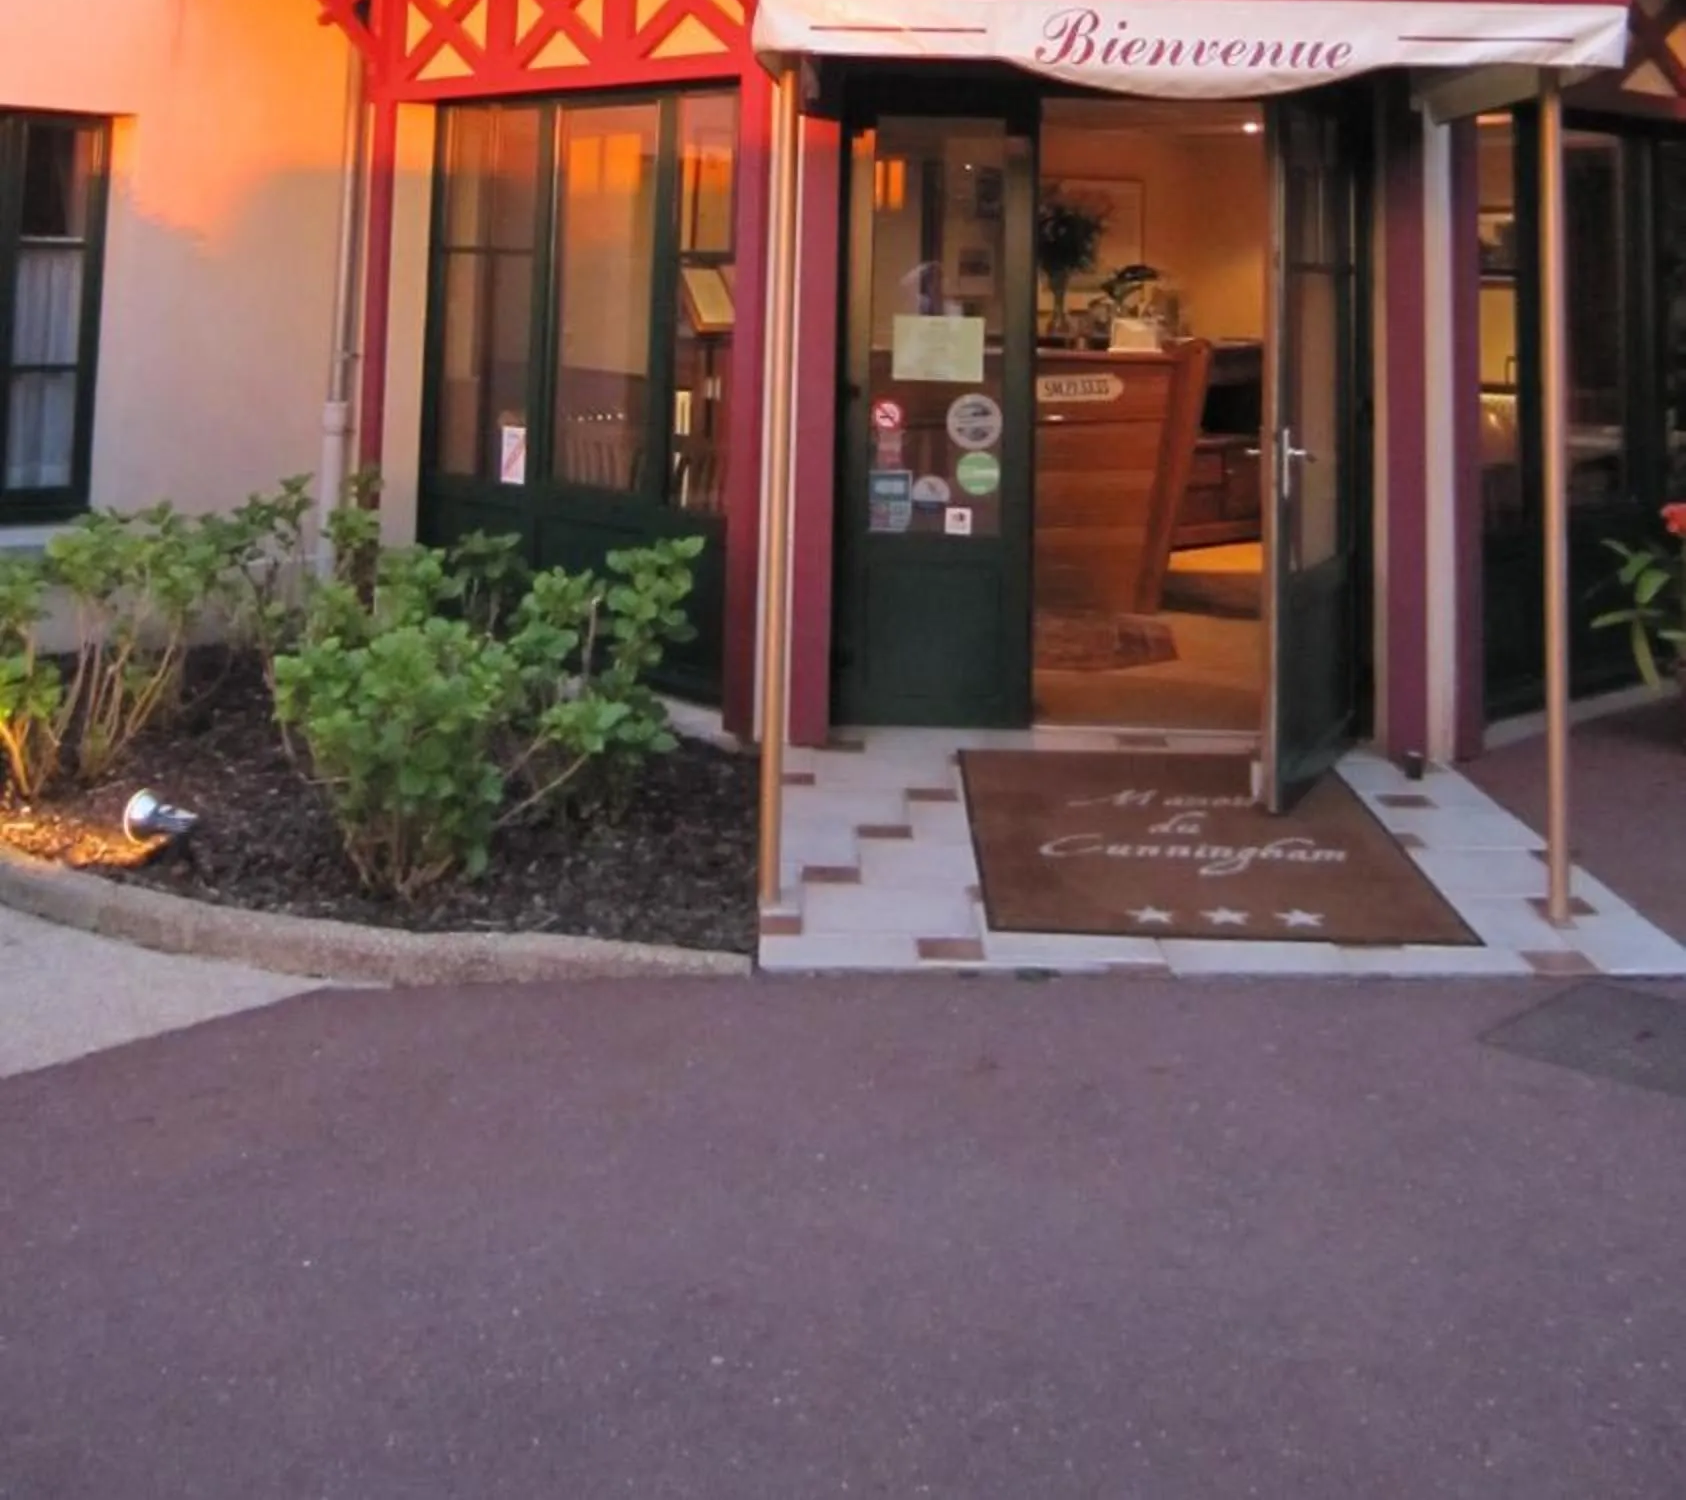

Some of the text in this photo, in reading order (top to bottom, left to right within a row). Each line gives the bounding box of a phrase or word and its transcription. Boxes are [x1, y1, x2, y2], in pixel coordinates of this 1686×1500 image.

[1034, 8, 1353, 71] Bienvenue
[1147, 811, 1207, 835] du
[1039, 834, 1348, 877] Cunningham
